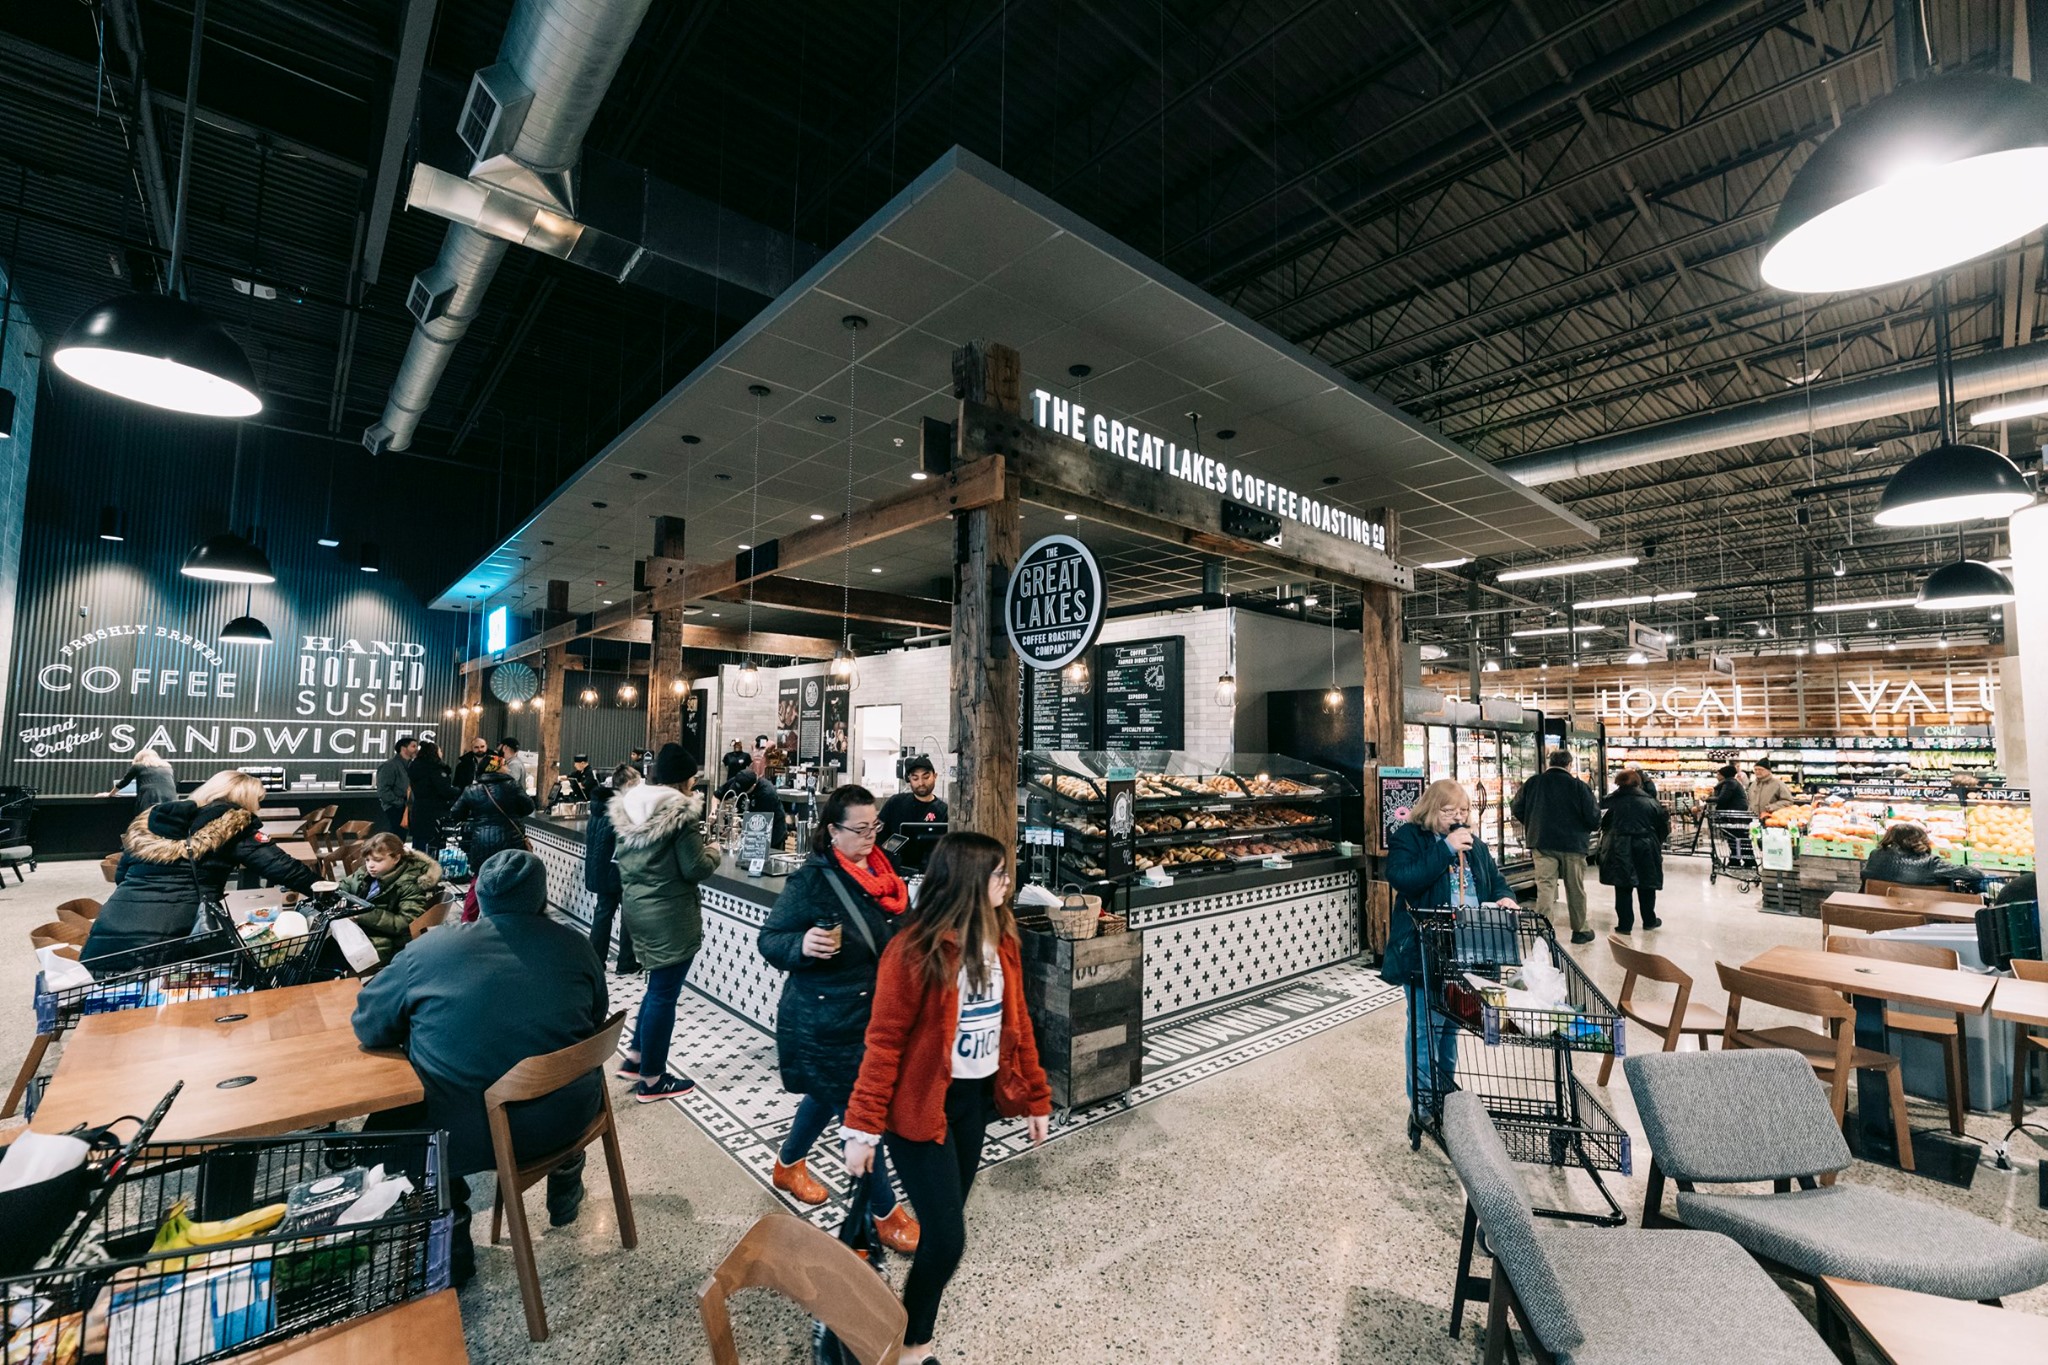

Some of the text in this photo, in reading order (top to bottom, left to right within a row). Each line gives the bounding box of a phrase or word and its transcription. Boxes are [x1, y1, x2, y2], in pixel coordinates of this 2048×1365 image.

[1032, 389, 1086, 443] THE
[1093, 414, 1166, 471] GREAT
[1169, 443, 1227, 494] LAKES
[1231, 469, 1298, 521] COFFEE
[1301, 496, 1371, 545] ROASTING
[1045, 547, 1058, 559] THE
[1020, 557, 1082, 598] GREAT
[1016, 589, 1087, 630] LAKES
[60, 623, 224, 667] FRESHLY BREWED
[301, 635, 426, 658] HAND
[1022, 629, 1081, 646] COFFEE ROASTING
[38, 664, 237, 698] COFFEE
[298, 655, 425, 692] ROLLED
[296, 690, 423, 719] SUSHI
[1601, 684, 1756, 718] LOCAL
[19, 717, 77, 744] Hand
[30, 727, 103, 758] Crafted
